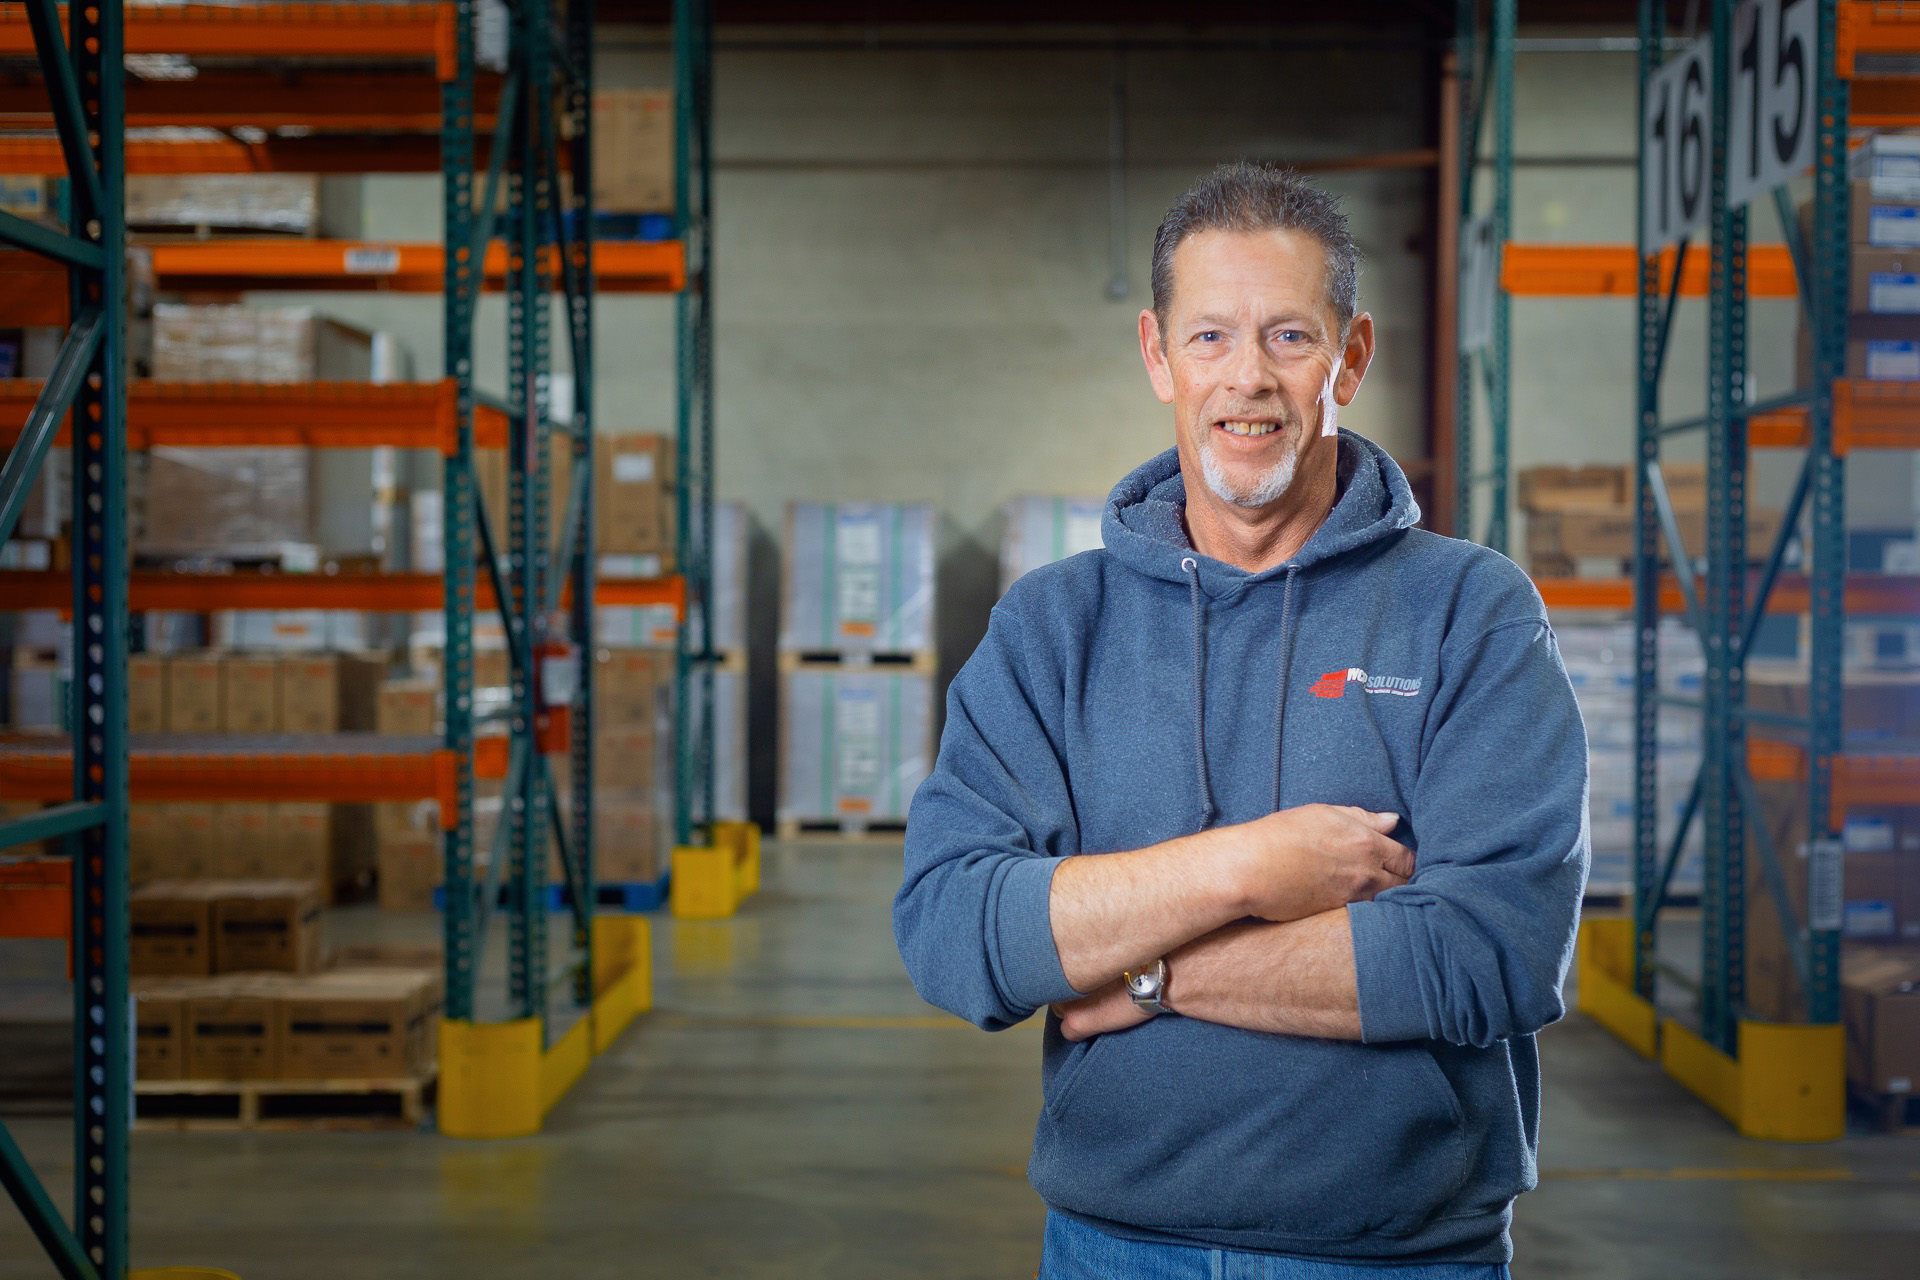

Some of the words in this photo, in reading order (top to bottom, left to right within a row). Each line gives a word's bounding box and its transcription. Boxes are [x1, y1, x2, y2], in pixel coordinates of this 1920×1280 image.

[1654, 60, 1703, 233] 16
[1741, 0, 1805, 181] 15
[1366, 676, 1422, 690] SOLUTIONS
